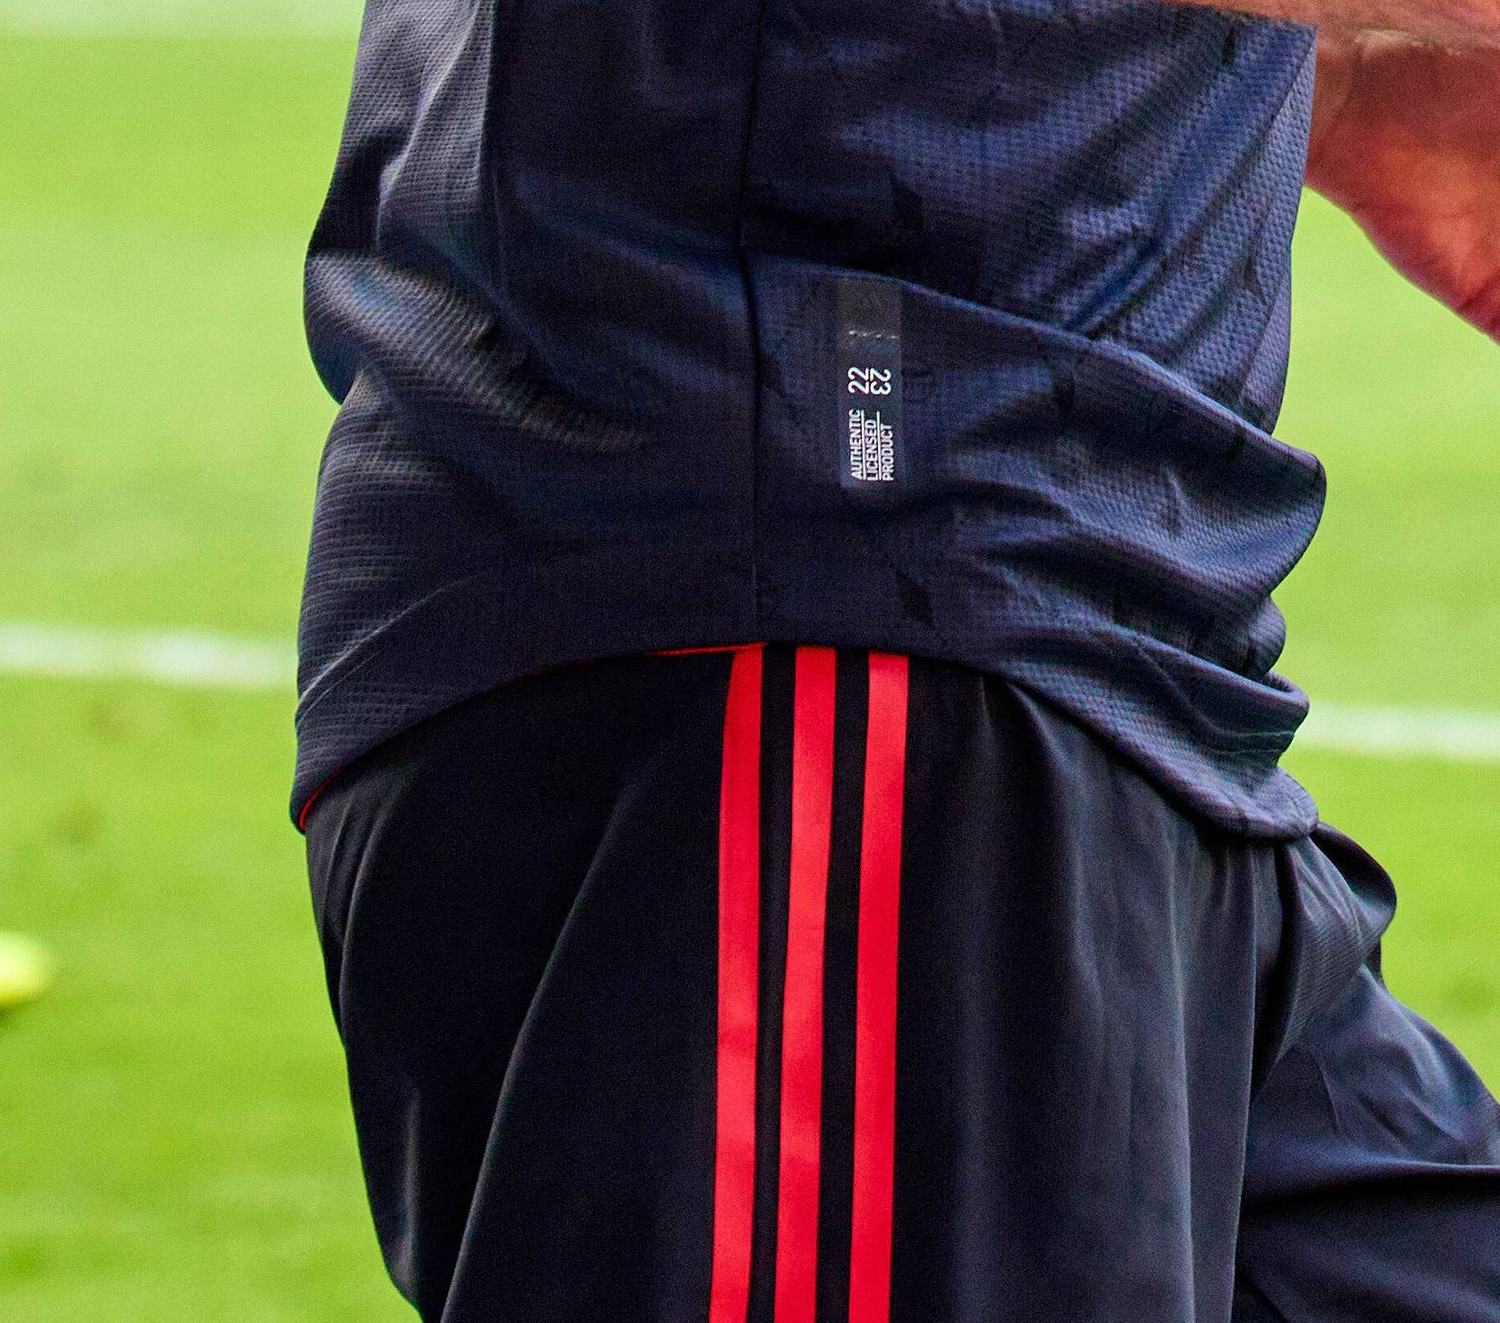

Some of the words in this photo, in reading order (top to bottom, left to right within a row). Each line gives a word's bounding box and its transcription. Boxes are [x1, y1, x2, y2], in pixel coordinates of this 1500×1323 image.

[848, 366, 869, 395] 22
[870, 367, 892, 395] 23
[848, 409, 863, 481] AUTHENTIC
[864, 419, 879, 482] LICENSED
[880, 423, 895, 482] PRODUCT
